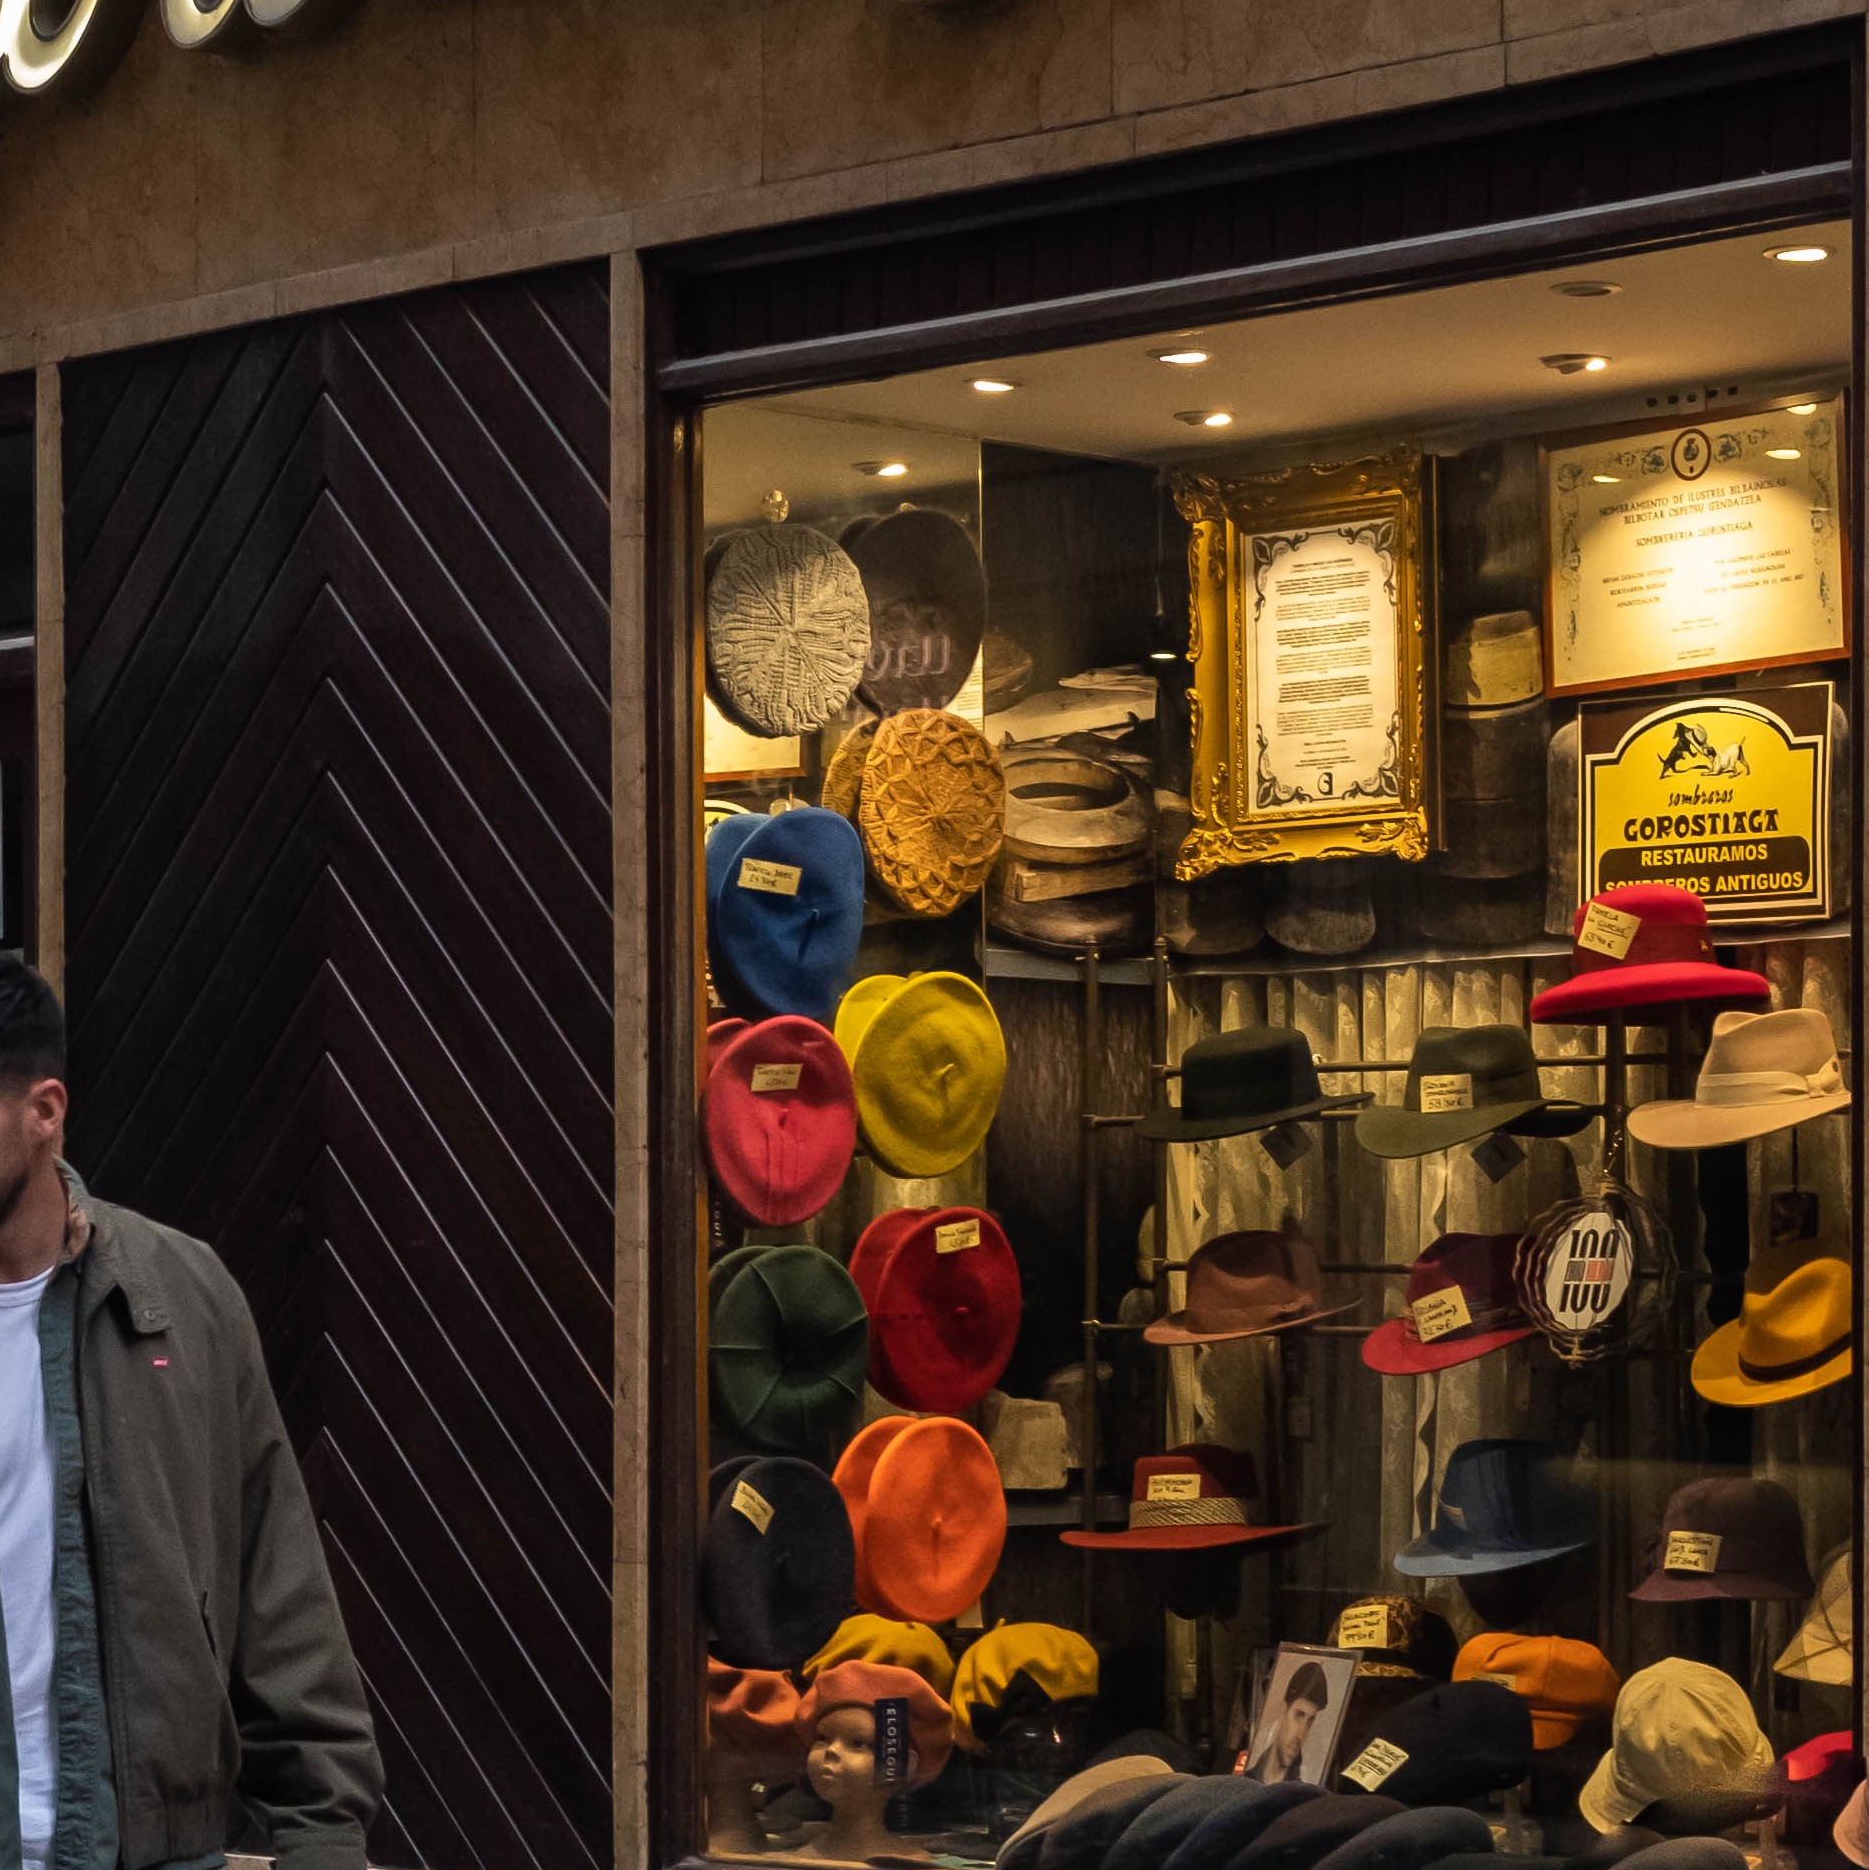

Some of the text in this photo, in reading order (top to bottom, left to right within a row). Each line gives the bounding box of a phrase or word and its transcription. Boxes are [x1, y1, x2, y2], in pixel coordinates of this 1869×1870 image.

[1599, 497, 1669, 516] NOMBRAMIENTO
[1624, 808, 1779, 842] GOROSTIAGA
[1641, 843, 1769, 867] RESTAURAMOS
[1715, 871, 1803, 892] ANTIGUOS
